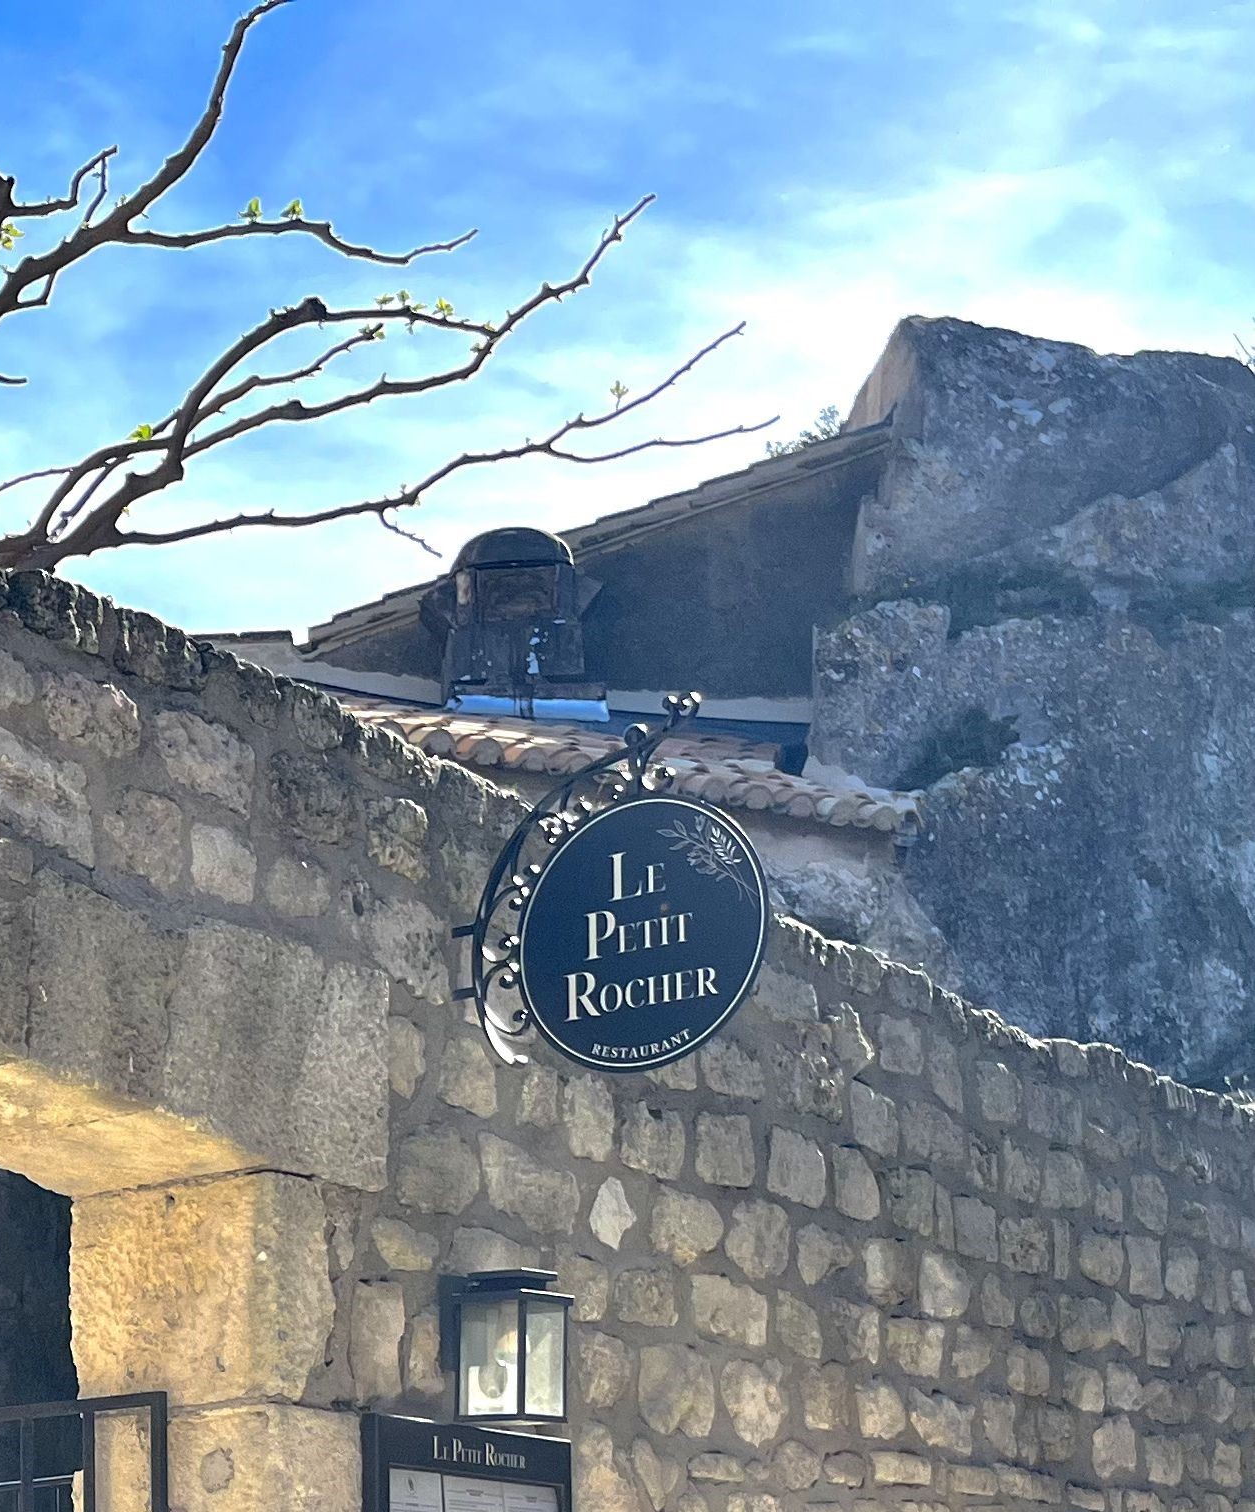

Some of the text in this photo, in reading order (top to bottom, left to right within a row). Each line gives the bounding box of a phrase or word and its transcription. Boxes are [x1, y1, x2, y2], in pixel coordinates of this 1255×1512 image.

[608, 851, 667, 902] LE
[584, 910, 693, 961] PETIT
[563, 967, 719, 1022] ROCHER
[591, 1028, 692, 1059] RESTAURANT
[433, 1436, 526, 1469] LE PETIT ROCHER
